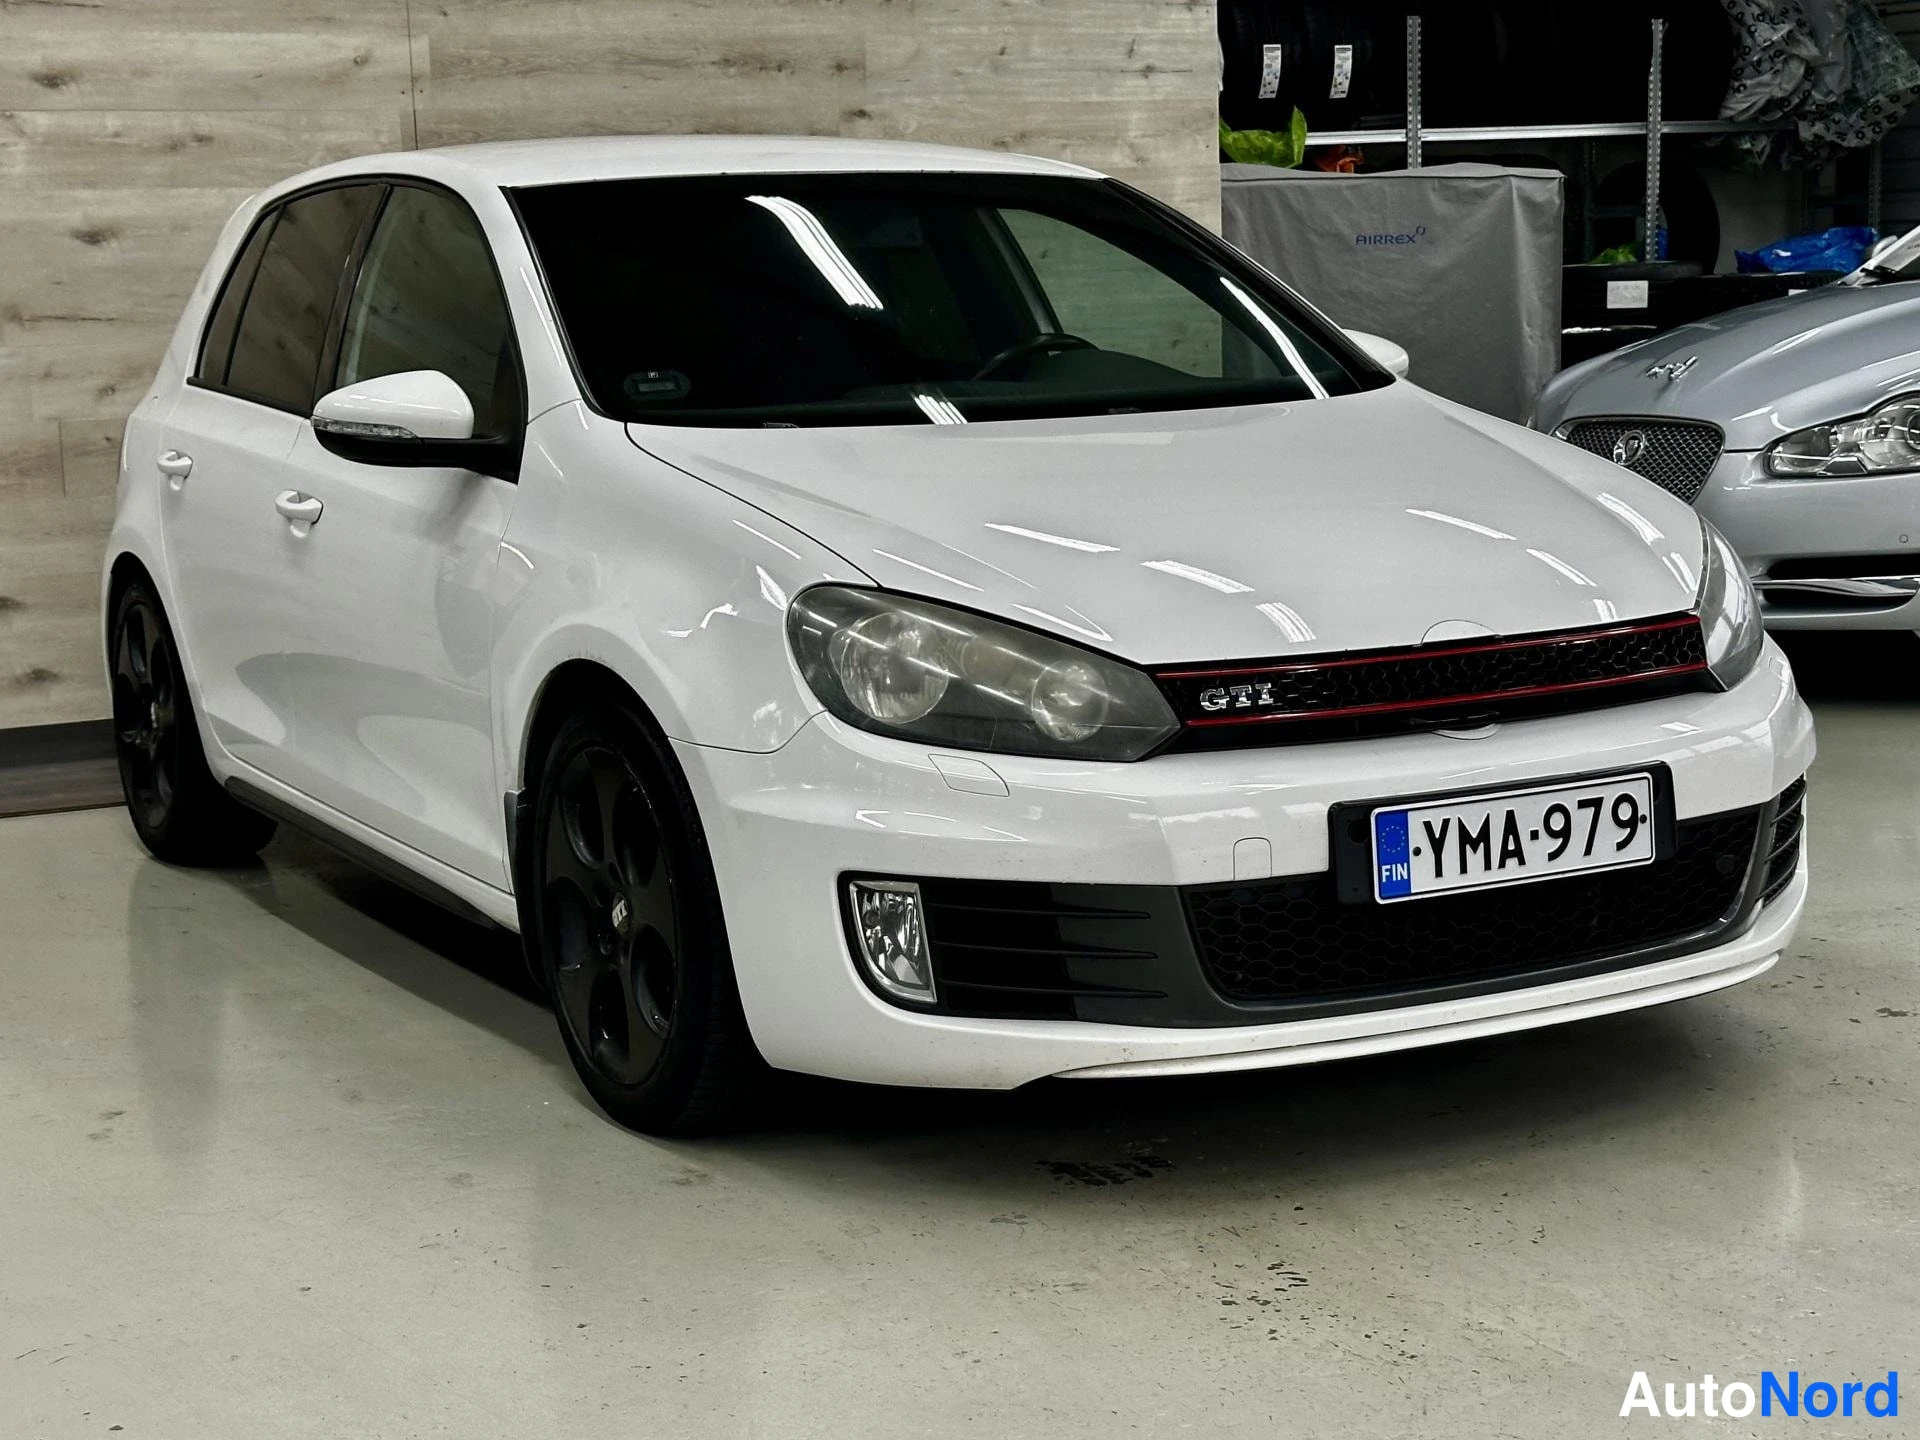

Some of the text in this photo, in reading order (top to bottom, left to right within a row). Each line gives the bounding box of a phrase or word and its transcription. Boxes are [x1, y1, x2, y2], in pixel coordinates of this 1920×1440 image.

[1356, 231, 1418, 245] AIRREX
[1200, 682, 1274, 711] GTI
[1422, 792, 1639, 878] YMA-979
[1381, 862, 1409, 883] FIN
